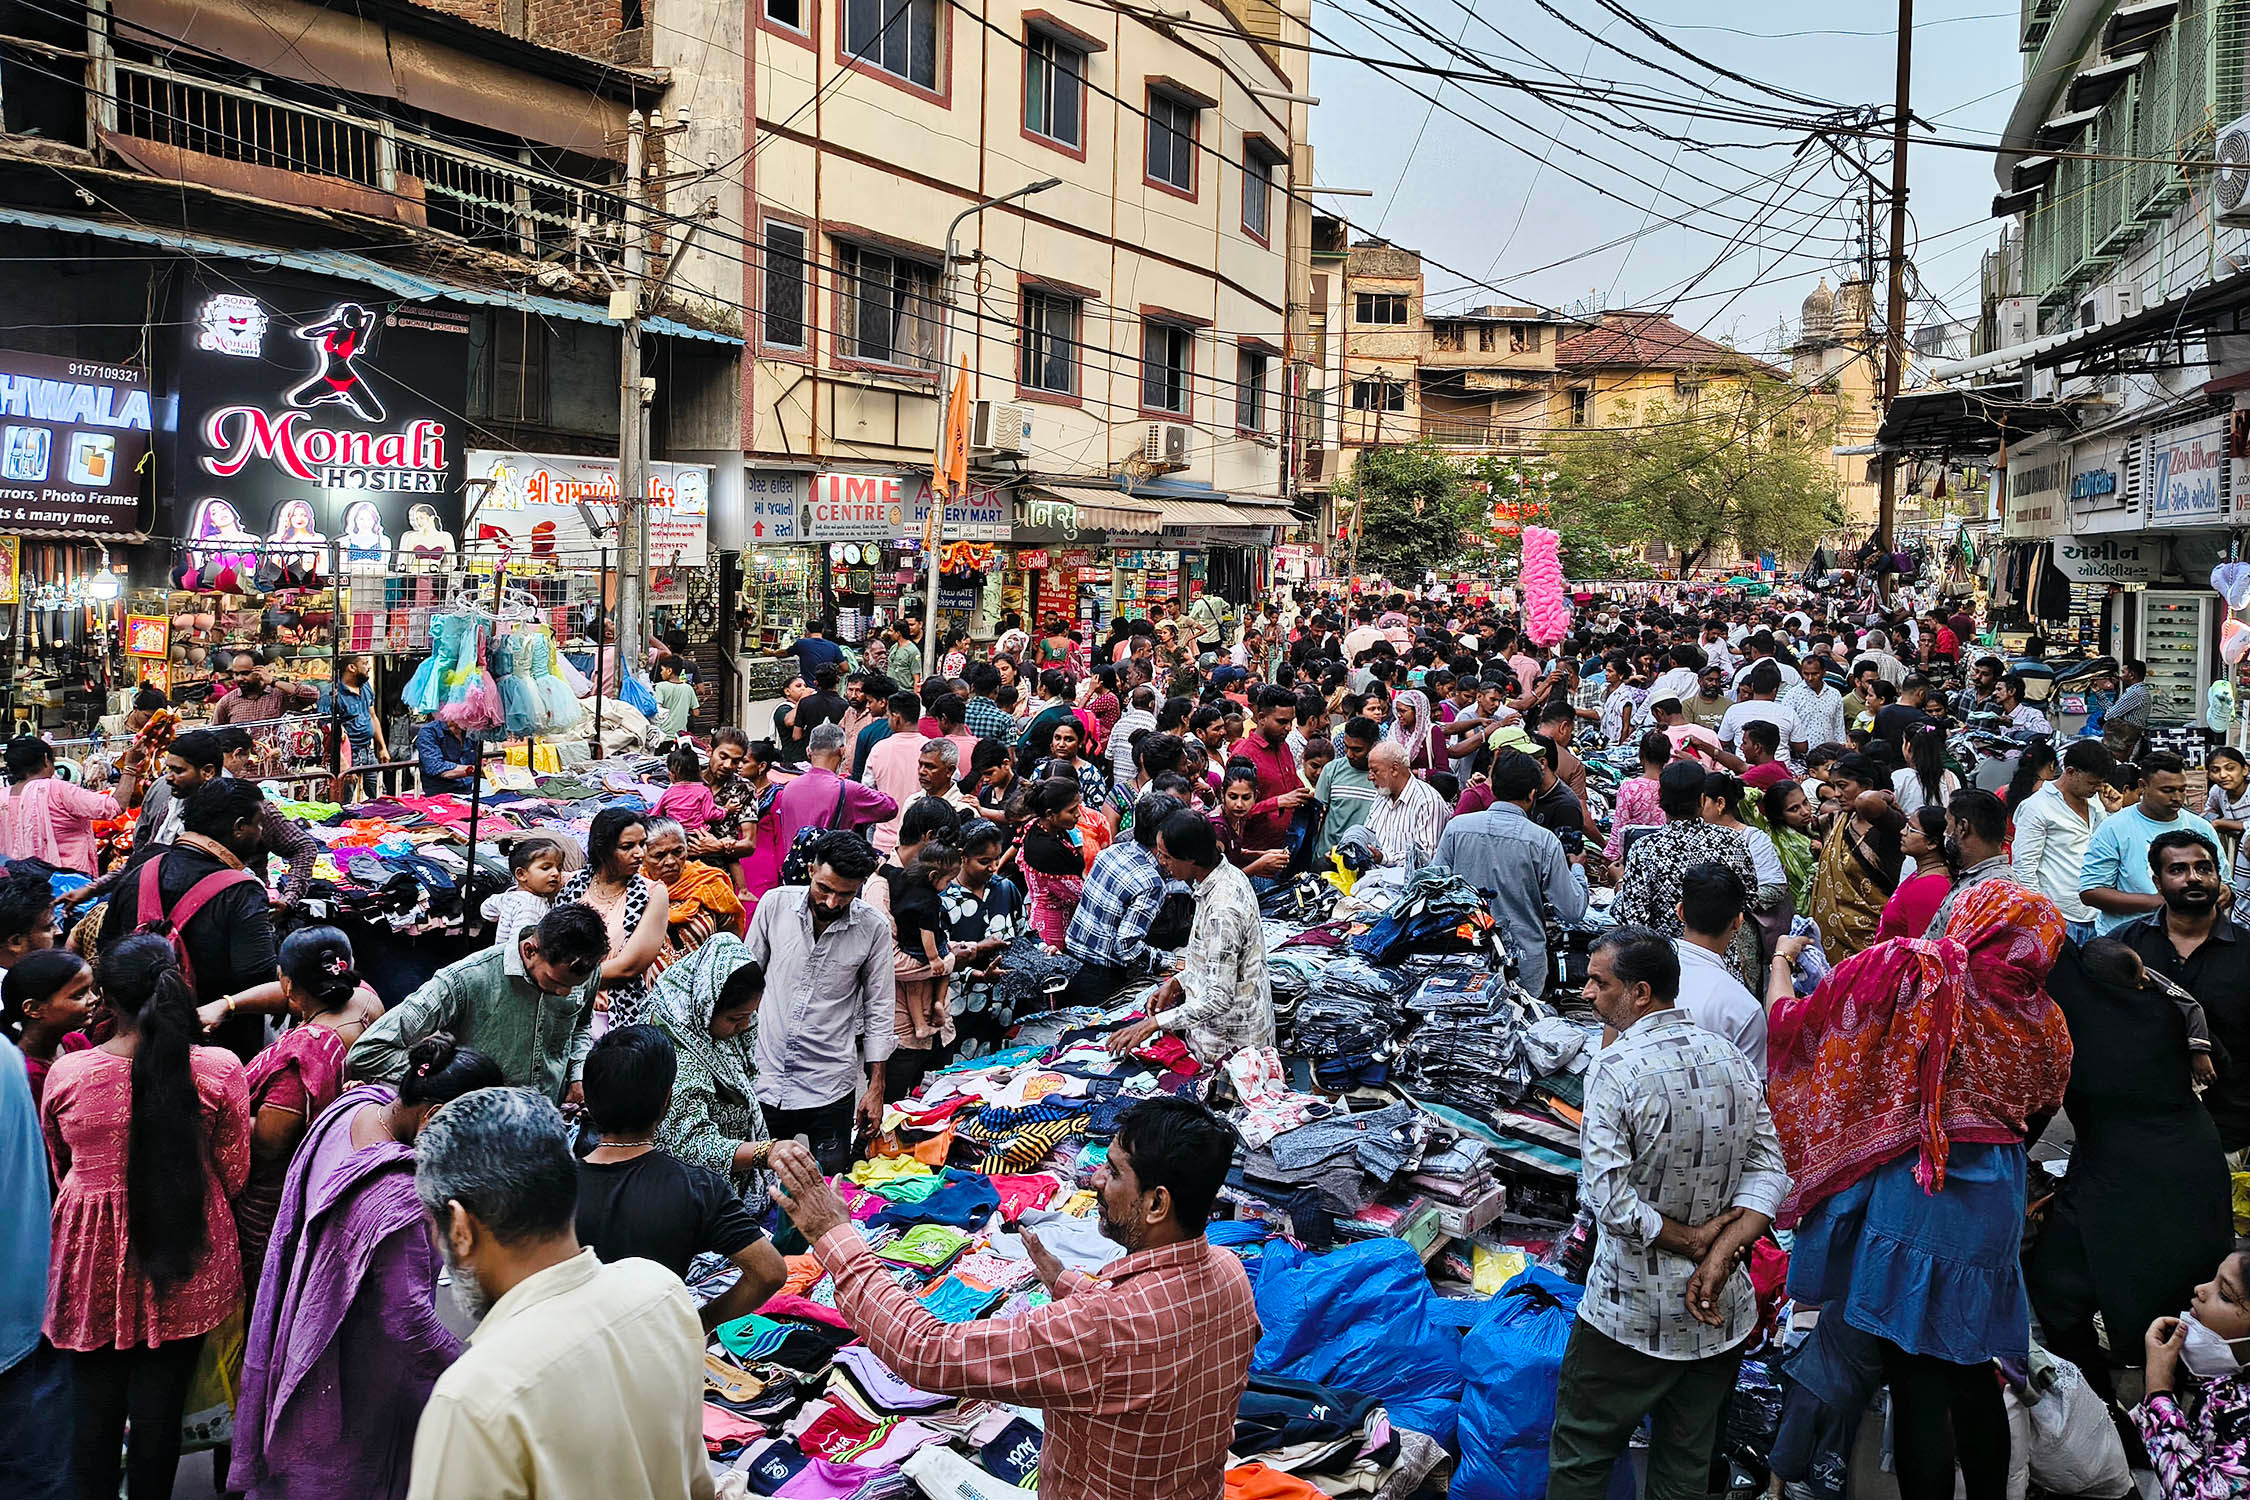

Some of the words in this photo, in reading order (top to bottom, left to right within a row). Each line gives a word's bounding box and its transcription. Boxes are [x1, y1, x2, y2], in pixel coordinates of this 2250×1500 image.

[223, 297, 255, 306] SONY
[68, 363, 139, 382] 9157109321
[204, 407, 448, 480] Monali
[327, 469, 448, 493] HOSIERY
[527, 471, 549, 503] શ્રી
[770, 475, 793, 493] હાઉસ
[808, 474, 901, 503] TIME
[42, 489, 86, 503] Photo
[88, 492, 139, 506] Frames
[14, 508, 26, 520] &
[29, 511, 71, 525] many
[73, 513, 113, 525] more.
[816, 505, 885, 521] CENTRE
[915, 506, 967, 521] HOERY
[970, 509, 1003, 522] MART
[774, 519, 794, 536] રસ્તો
[2062, 540, 2139, 560] અમીન
